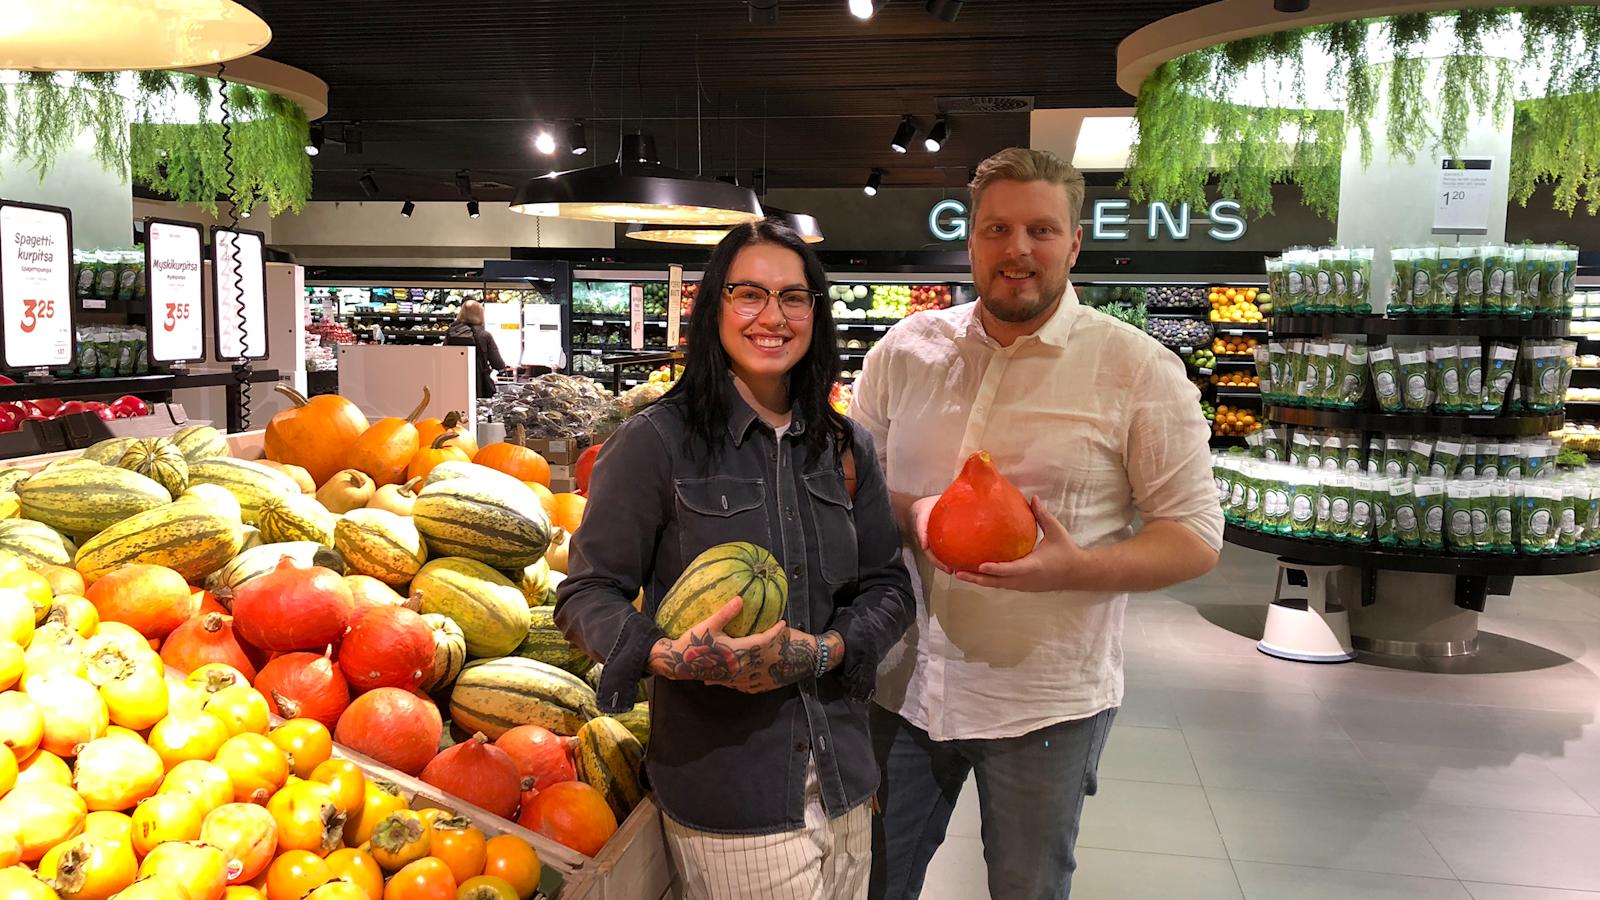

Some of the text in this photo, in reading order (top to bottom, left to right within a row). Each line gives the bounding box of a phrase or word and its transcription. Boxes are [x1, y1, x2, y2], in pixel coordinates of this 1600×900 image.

[928, 199, 1248, 241] GENS
[14, 232, 54, 248] Spagetti-
[18, 248, 54, 263] kurpitsa
[153, 259, 198, 272] Myskikurpitsa
